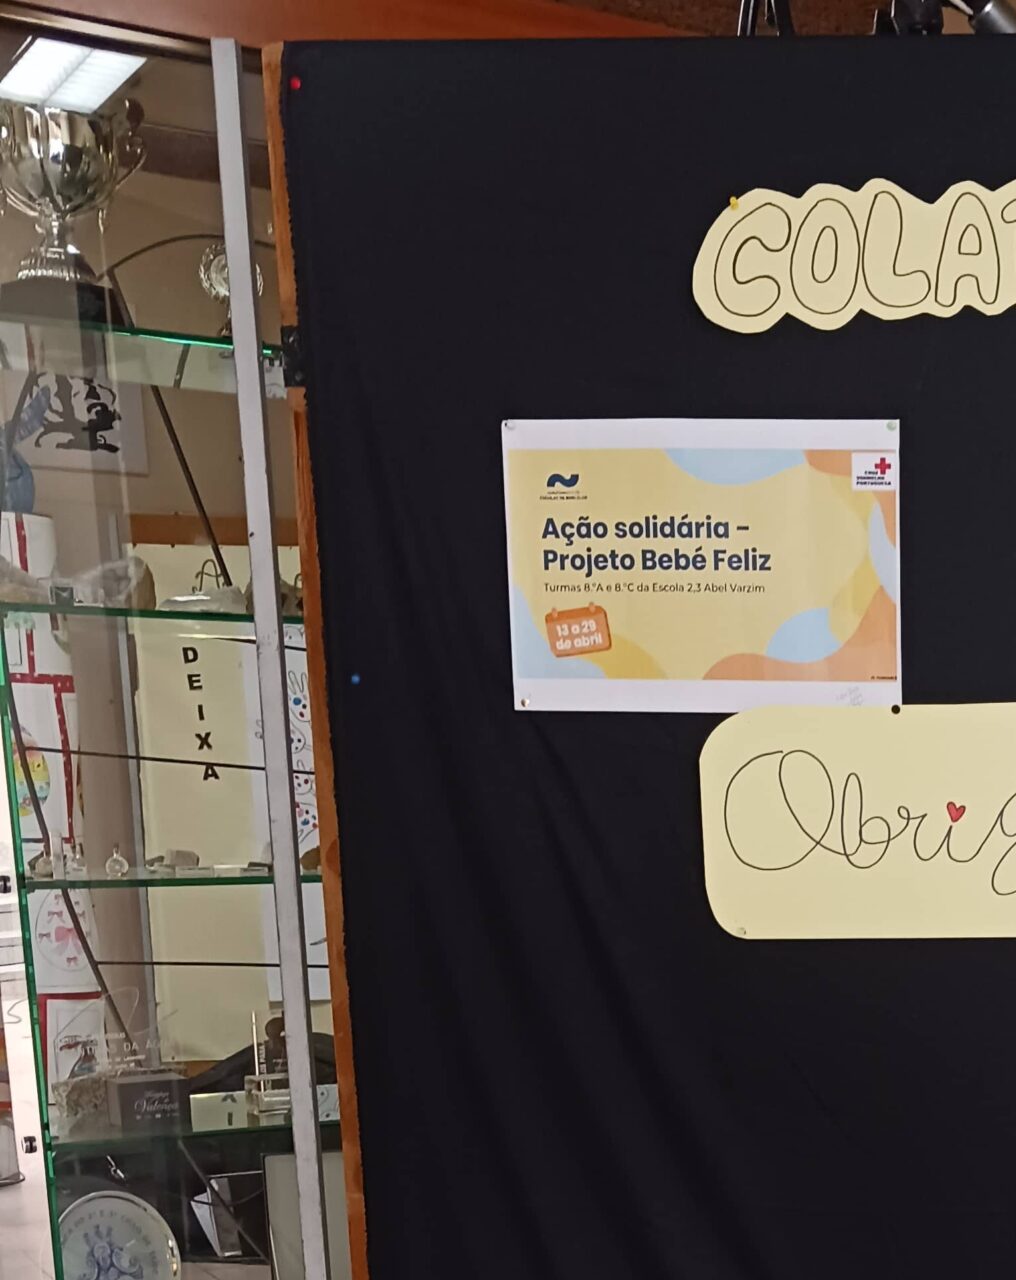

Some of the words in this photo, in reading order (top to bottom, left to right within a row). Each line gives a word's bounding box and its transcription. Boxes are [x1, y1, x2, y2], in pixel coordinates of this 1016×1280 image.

[541, 515, 608, 546] Ação
[614, 513, 730, 539] solidária
[543, 546, 635, 578] Projeto
[641, 545, 707, 571] Bebé
[713, 546, 772, 571] Feliz
[544, 582, 581, 592] Turmas
[637, 582, 649, 592] da
[652, 582, 684, 592] Escola
[704, 582, 727, 593] Abel
[729, 583, 766, 593] Varzim
[573, 632, 602, 648] abril
